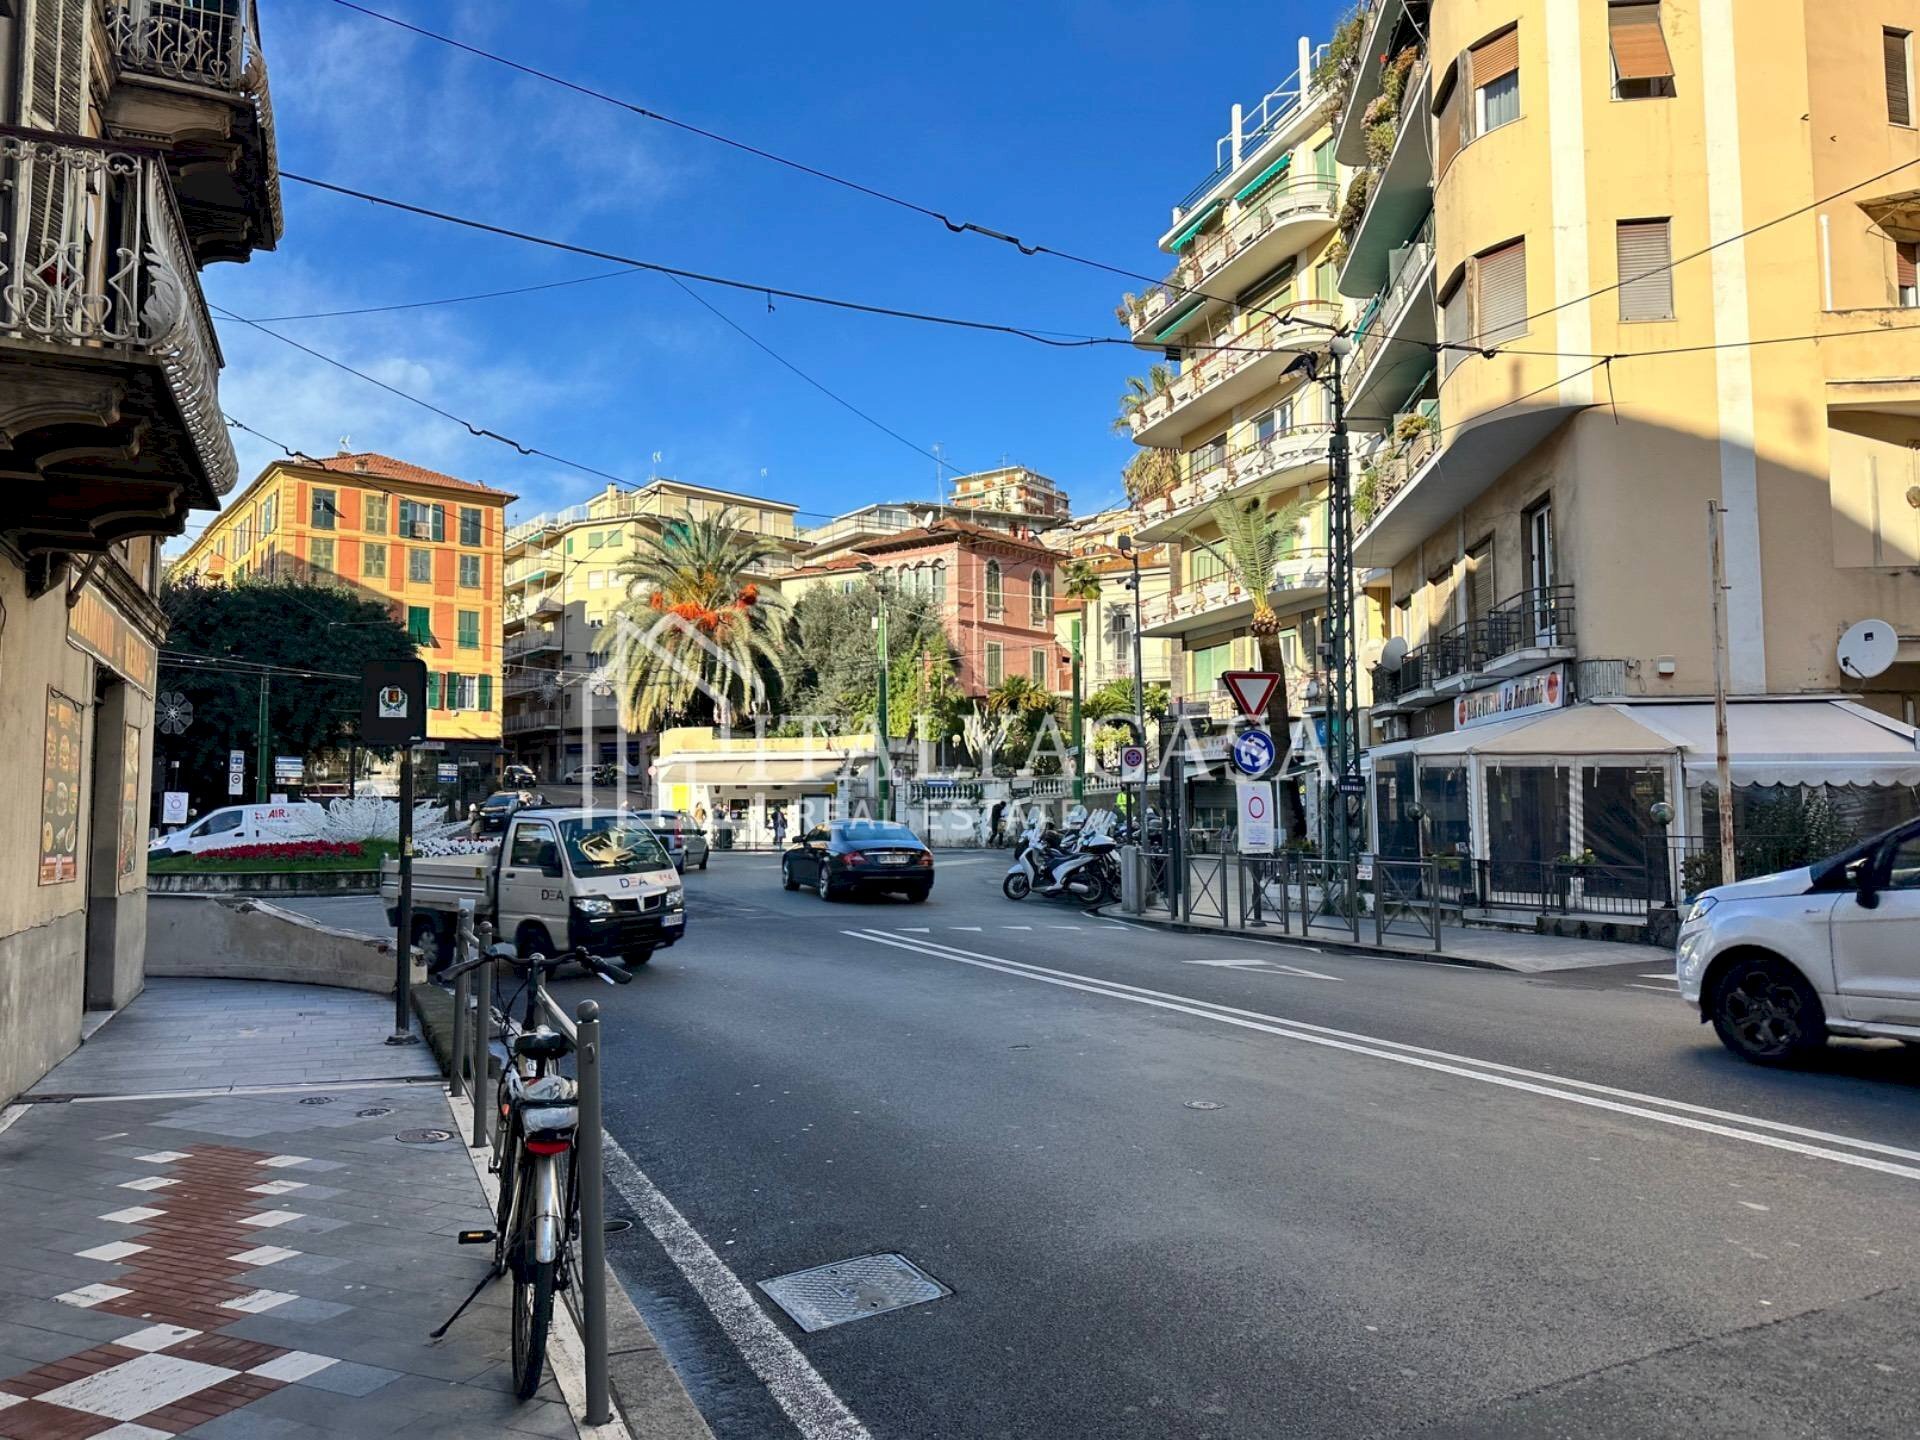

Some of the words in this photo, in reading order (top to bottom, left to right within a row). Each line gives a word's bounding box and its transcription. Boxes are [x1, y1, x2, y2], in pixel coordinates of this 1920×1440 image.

[268, 808, 286, 818] AIR
[619, 876, 649, 889] DEA
[541, 889, 565, 901] DEA
